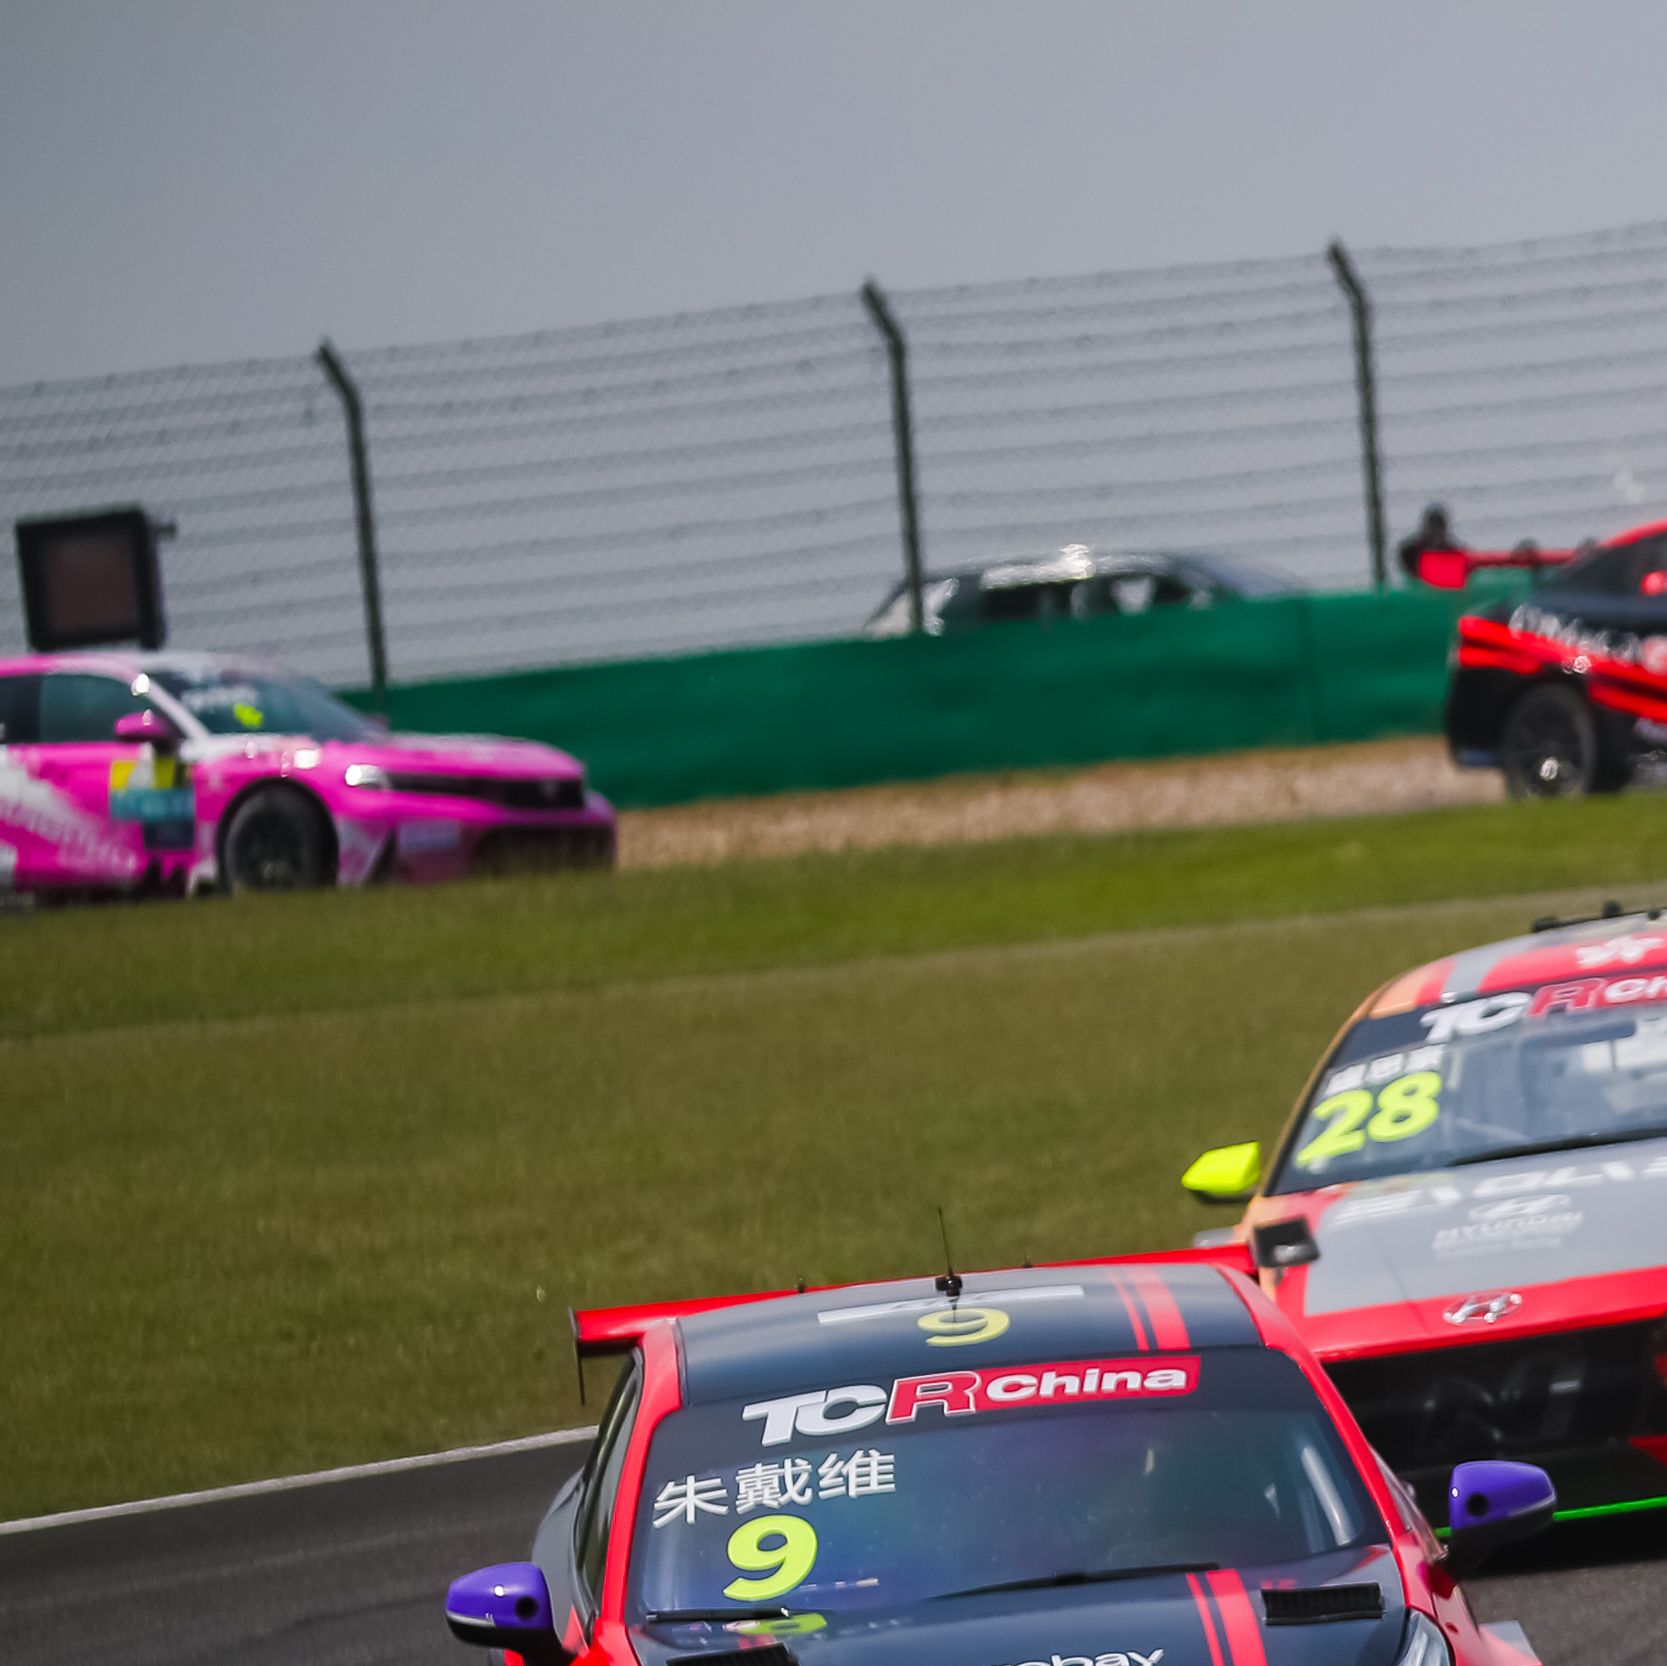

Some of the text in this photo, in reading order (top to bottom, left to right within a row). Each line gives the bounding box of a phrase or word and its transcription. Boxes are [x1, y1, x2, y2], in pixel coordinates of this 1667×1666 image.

[1296, 1071, 1442, 1168] 28
[917, 1307, 1010, 1347] 9
[742, 1366, 1188, 1447] TCR China
[652, 1449, 896, 1529] 朱戴维
[723, 1514, 818, 1601] 9
